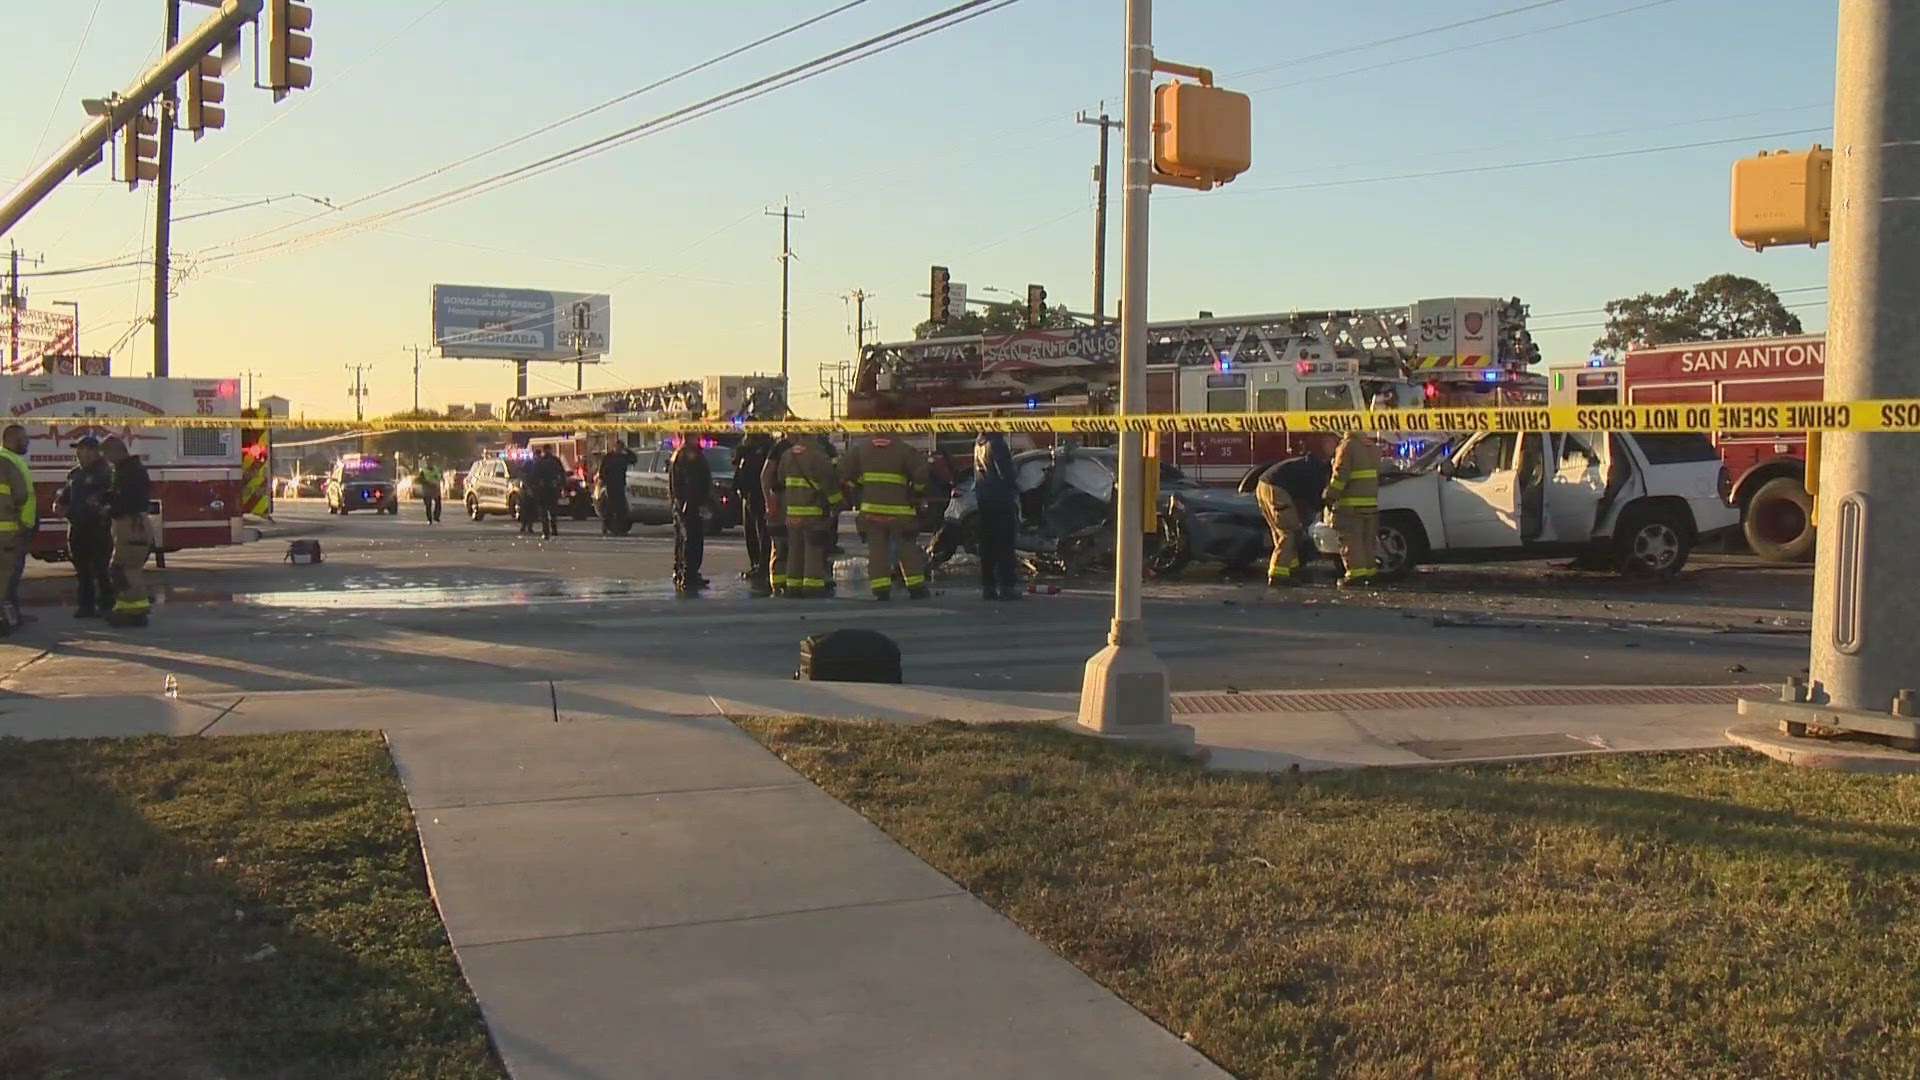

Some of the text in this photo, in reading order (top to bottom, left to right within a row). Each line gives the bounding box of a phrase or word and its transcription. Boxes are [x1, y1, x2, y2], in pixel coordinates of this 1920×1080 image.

[443, 296, 546, 310] GONZABA DIFFERENCE
[1421, 314, 1452, 342] 35
[989, 334, 1119, 362] SAN ANTONIO
[1681, 344, 1825, 372] SAN ANTON
[33, 392, 76, 408] ANTONIO
[197, 399, 214, 414] 35
[1071, 417, 1288, 432] CRIME SCENE DO NOT CROSS
[1308, 411, 1551, 431] CRIME SCENE DO NOT CROSS
[1576, 406, 1850, 430] CRIME SCENE DO NOT CROSS
[1221, 447, 1232, 456] 35
[630, 485, 670, 500] POLICE
